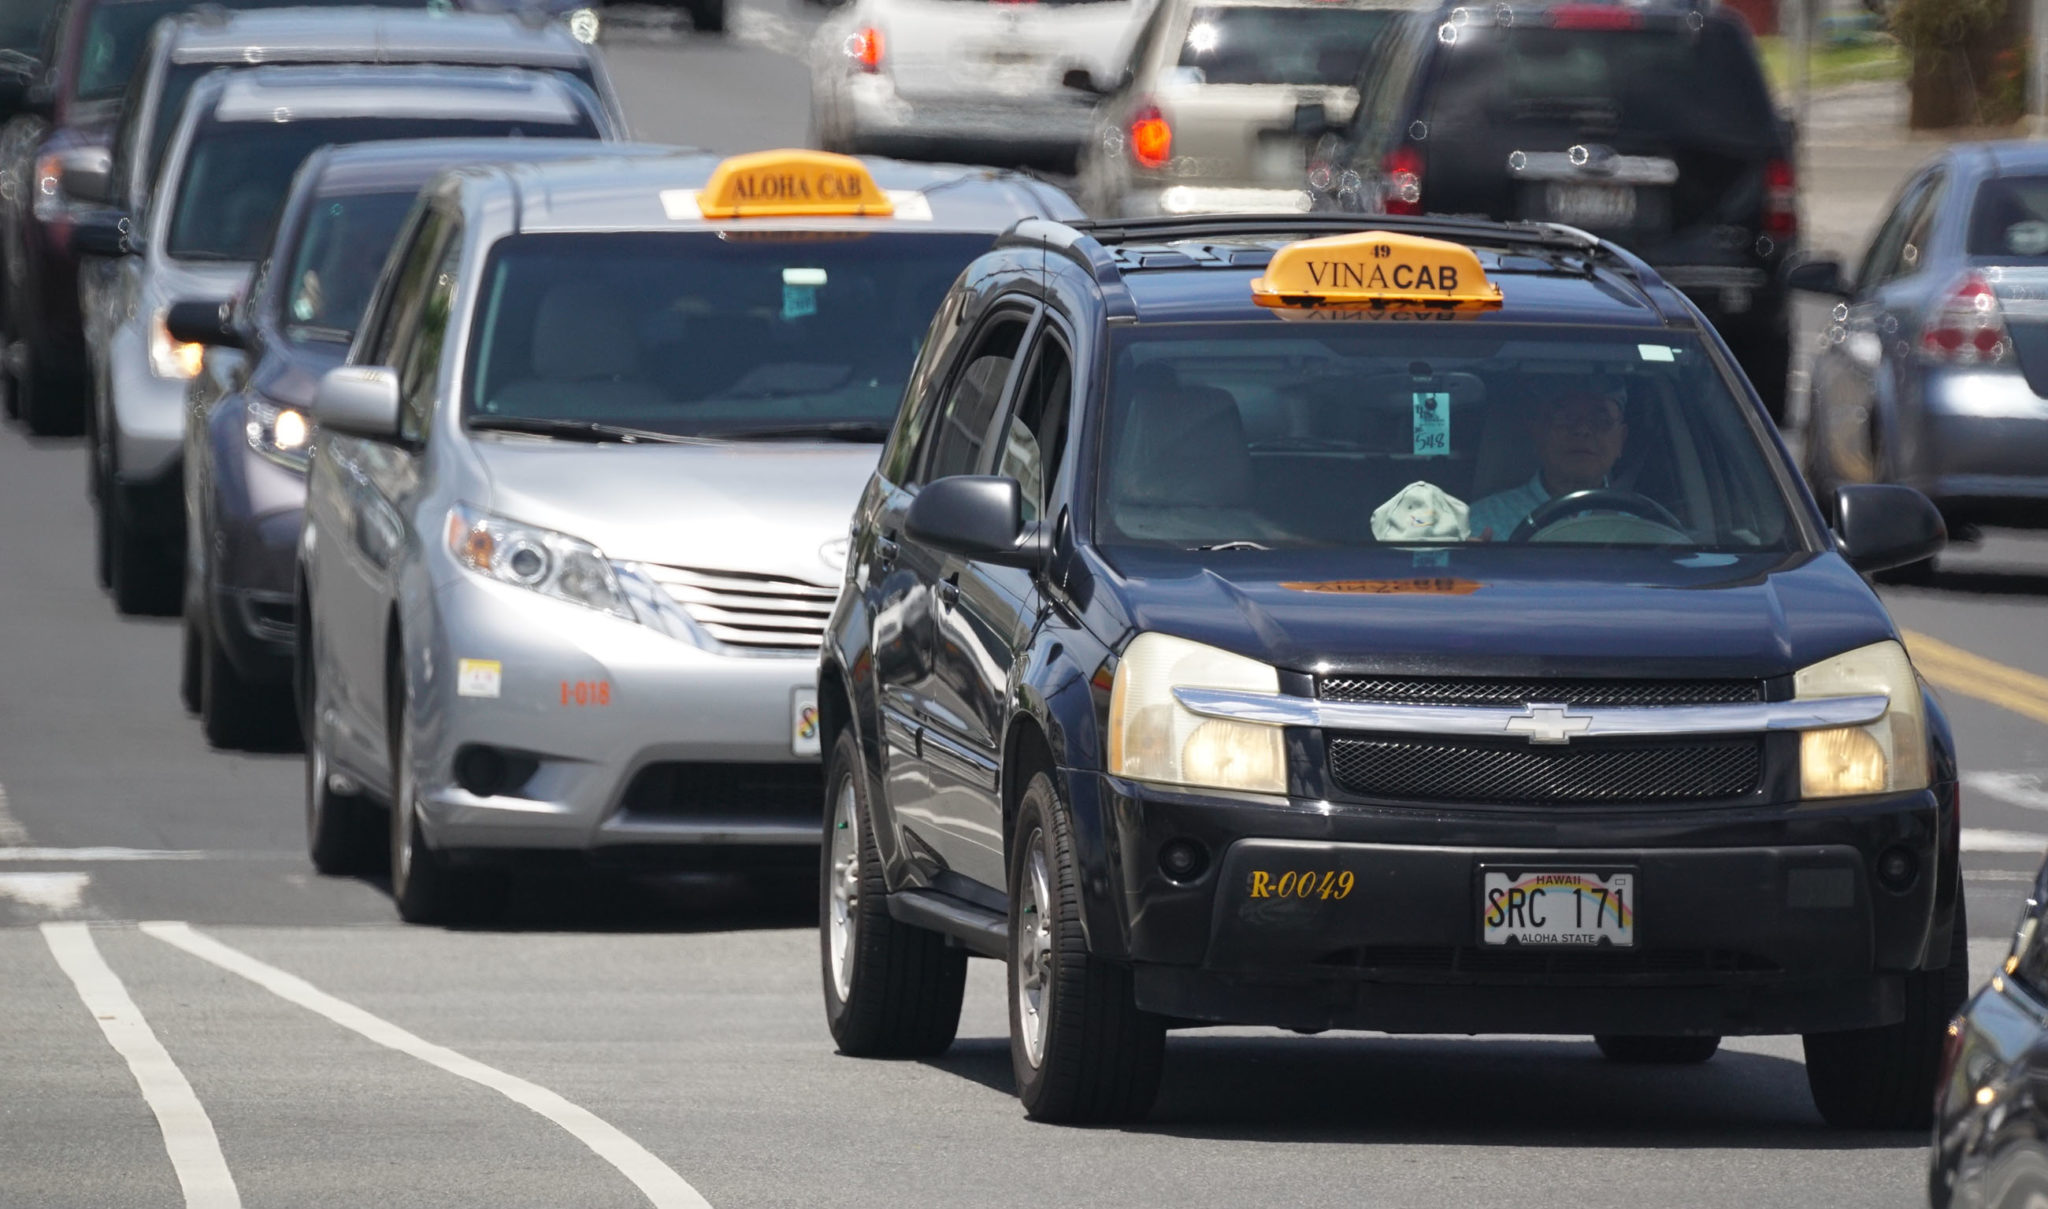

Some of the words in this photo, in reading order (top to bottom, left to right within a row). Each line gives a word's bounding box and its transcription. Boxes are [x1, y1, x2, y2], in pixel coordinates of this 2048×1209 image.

[734, 175, 809, 200] ALOHA
[817, 173, 862, 199] CAB
[1372, 244, 1391, 259] 49
[1250, 870, 1354, 900] R-0049
[1536, 875, 1581, 885] HAWAII
[1488, 888, 1546, 928] SRC
[1573, 888, 1624, 928] 171
[1521, 933, 1558, 943] ALOHA
[1562, 933, 1595, 943] STATE
